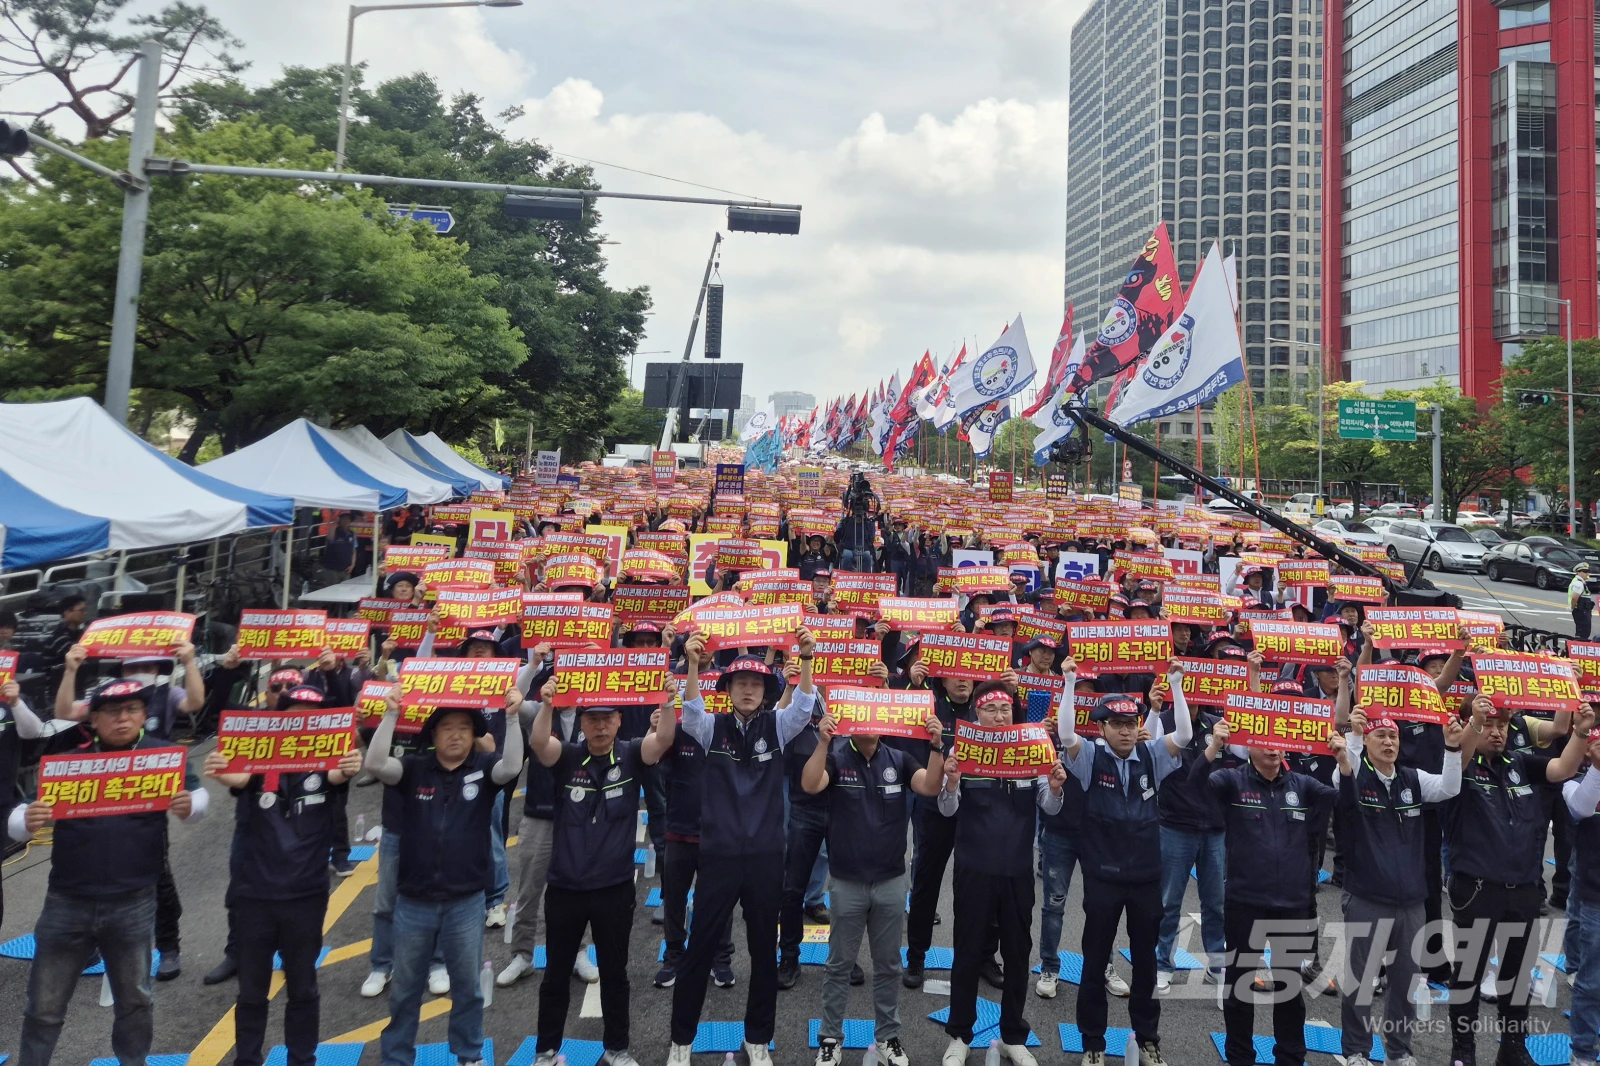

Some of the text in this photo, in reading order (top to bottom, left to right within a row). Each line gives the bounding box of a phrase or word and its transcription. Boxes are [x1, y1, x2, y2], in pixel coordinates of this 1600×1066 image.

[426, 561, 495, 571] 레미콘제조사의 단체교섭
[425, 569, 493, 583] 강력히 촉구한다
[958, 576, 1008, 585] 강력히 촉구한다
[1279, 570, 1329, 582] 강력히 촉구한다
[438, 586, 521, 600] 레미콘제조사의 단체교섭
[617, 587, 688, 597] 레미콘제조사의 단체교섭
[790, 582, 812, 591] 단체교섭
[875, 583, 895, 591] 단체교섭
[1057, 580, 1109, 594] 레미콘제조사의 단체교섭
[1355, 586, 1382, 596] 촉구한다
[752, 593, 775, 604] 강력히
[779, 594, 812, 606] 촉구한다
[835, 591, 859, 603] 강력히
[881, 599, 957, 608] 레미콘제조사의 단체교섭
[1055, 589, 1107, 606] 강력히 촉구한다
[438, 598, 521, 618] 강력히 촉구한다
[524, 606, 611, 619] 레미콘제조사의 단체교섭
[614, 599, 688, 613] 강력히 촉구한다
[697, 605, 799, 621] 레미콘제조사의 단체교섭
[1164, 604, 1223, 618] 강력히 촉구한다
[88, 613, 195, 631] 레미콘제조사의 단체교섭
[242, 614, 325, 626] 레미콘제조사의 단체교섭
[881, 608, 958, 622] 강력히 촉구한다
[1367, 609, 1456, 621] 레미콘제조사의 단체교섭
[337, 623, 367, 632] 단체교섭
[390, 625, 422, 640] 강력히
[523, 619, 611, 639] 강력히 촉구한다
[698, 617, 801, 638] 강력히 촉구한다
[1071, 624, 1170, 639] 레미콘제조사의 단체교섭
[1253, 621, 1338, 636] 레미콘제조사의 단체교섭
[1411, 623, 1459, 639] 촉구한다
[1470, 626, 1495, 634] 단체교섭
[81, 630, 124, 647] 강력히
[239, 628, 326, 648] 강력히 촉구한다
[922, 634, 1010, 651] 레미콘제조사의 단체교섭
[1255, 634, 1342, 657] 강력히 촉구한다
[849, 644, 878, 654] 단체교섭
[1072, 639, 1171, 662] 강력히 촉구한다
[403, 660, 515, 674] 레미콘제조사의 단체교섭
[557, 652, 666, 667] 레미콘제조사의 단체교섭
[920, 648, 1009, 672] 강력히 촉구한다
[1217, 664, 1247, 677] 단체교섭
[1476, 659, 1573, 678] 레미콘제조사의 단체교섭
[556, 669, 665, 694] 강력히 촉구한다
[1361, 669, 1422, 684] 레미콘제조사의
[401, 675, 514, 695] 강력히 촉구한다
[1479, 675, 1580, 699] 강력히 촉구한다
[829, 689, 930, 704] 레미콘제조사의 단체교섭
[1360, 685, 1401, 710] 강력히
[1226, 693, 1331, 718] 레미콘제조사의 단체교섭
[829, 702, 931, 725] 강력히 촉구한다
[222, 712, 353, 733] 레미콘제조사의 단체교섭
[1228, 711, 1333, 742] 강력히 촉구한다
[958, 725, 1048, 742] 레미콘제조사의 단체교섭
[220, 731, 352, 760] 강력히 촉구한다
[956, 742, 1055, 768] 강력히 촉구한다
[42, 753, 182, 777] 레미콘제조사의 단체교섭
[41, 772, 182, 806] 강력히 촉구한다
